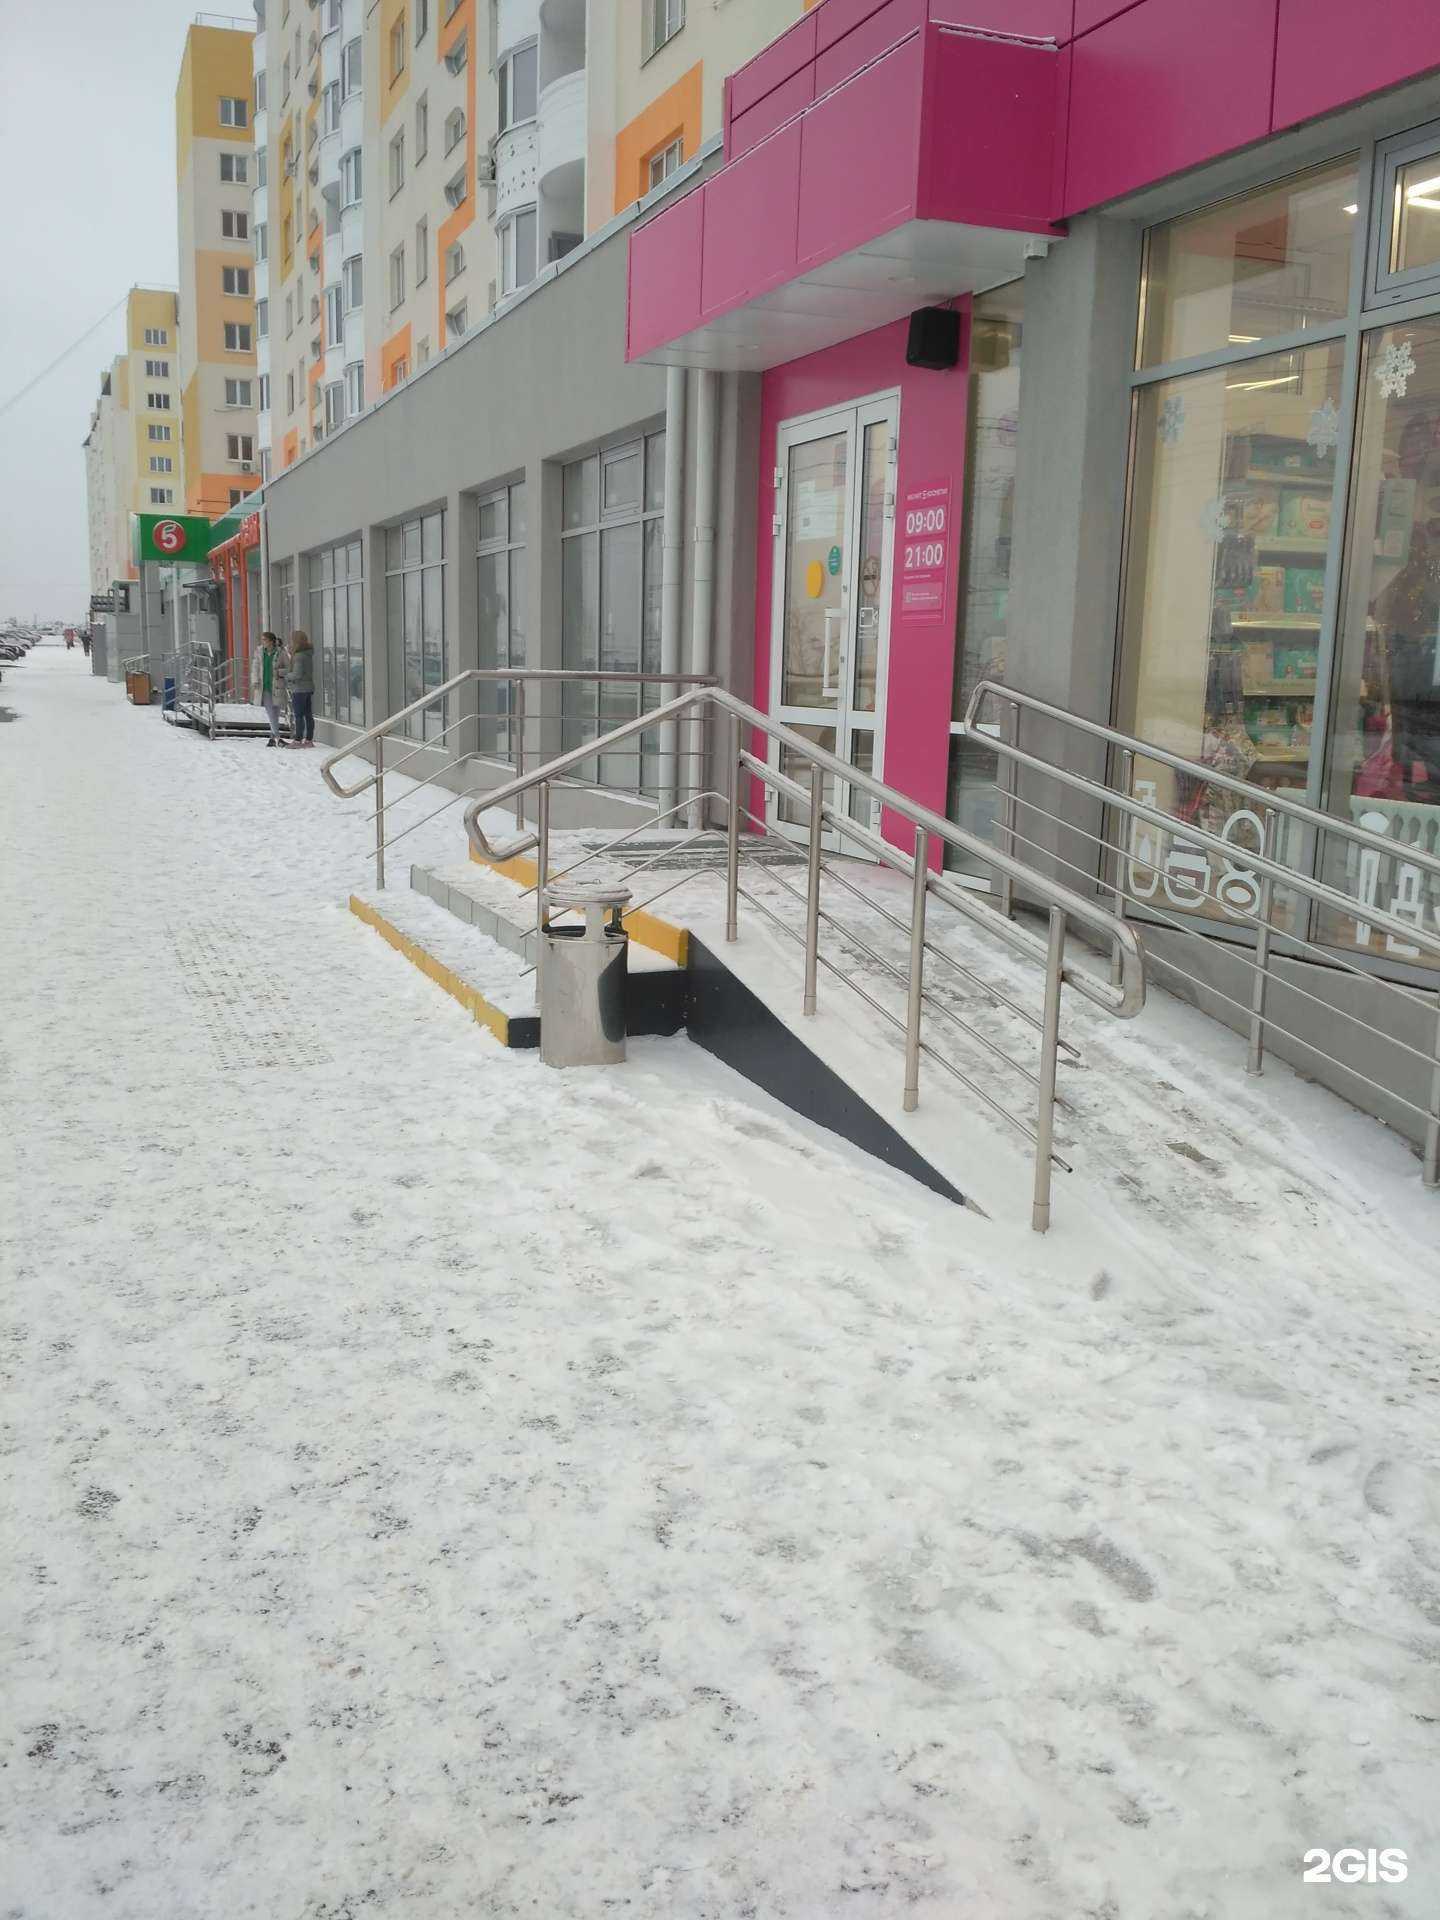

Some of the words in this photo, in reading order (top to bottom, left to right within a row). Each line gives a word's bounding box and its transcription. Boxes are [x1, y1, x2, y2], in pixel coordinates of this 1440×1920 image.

[906, 508, 944, 534] 09:00
[161, 523, 178, 549] 5
[904, 543, 943, 568] 21:00
